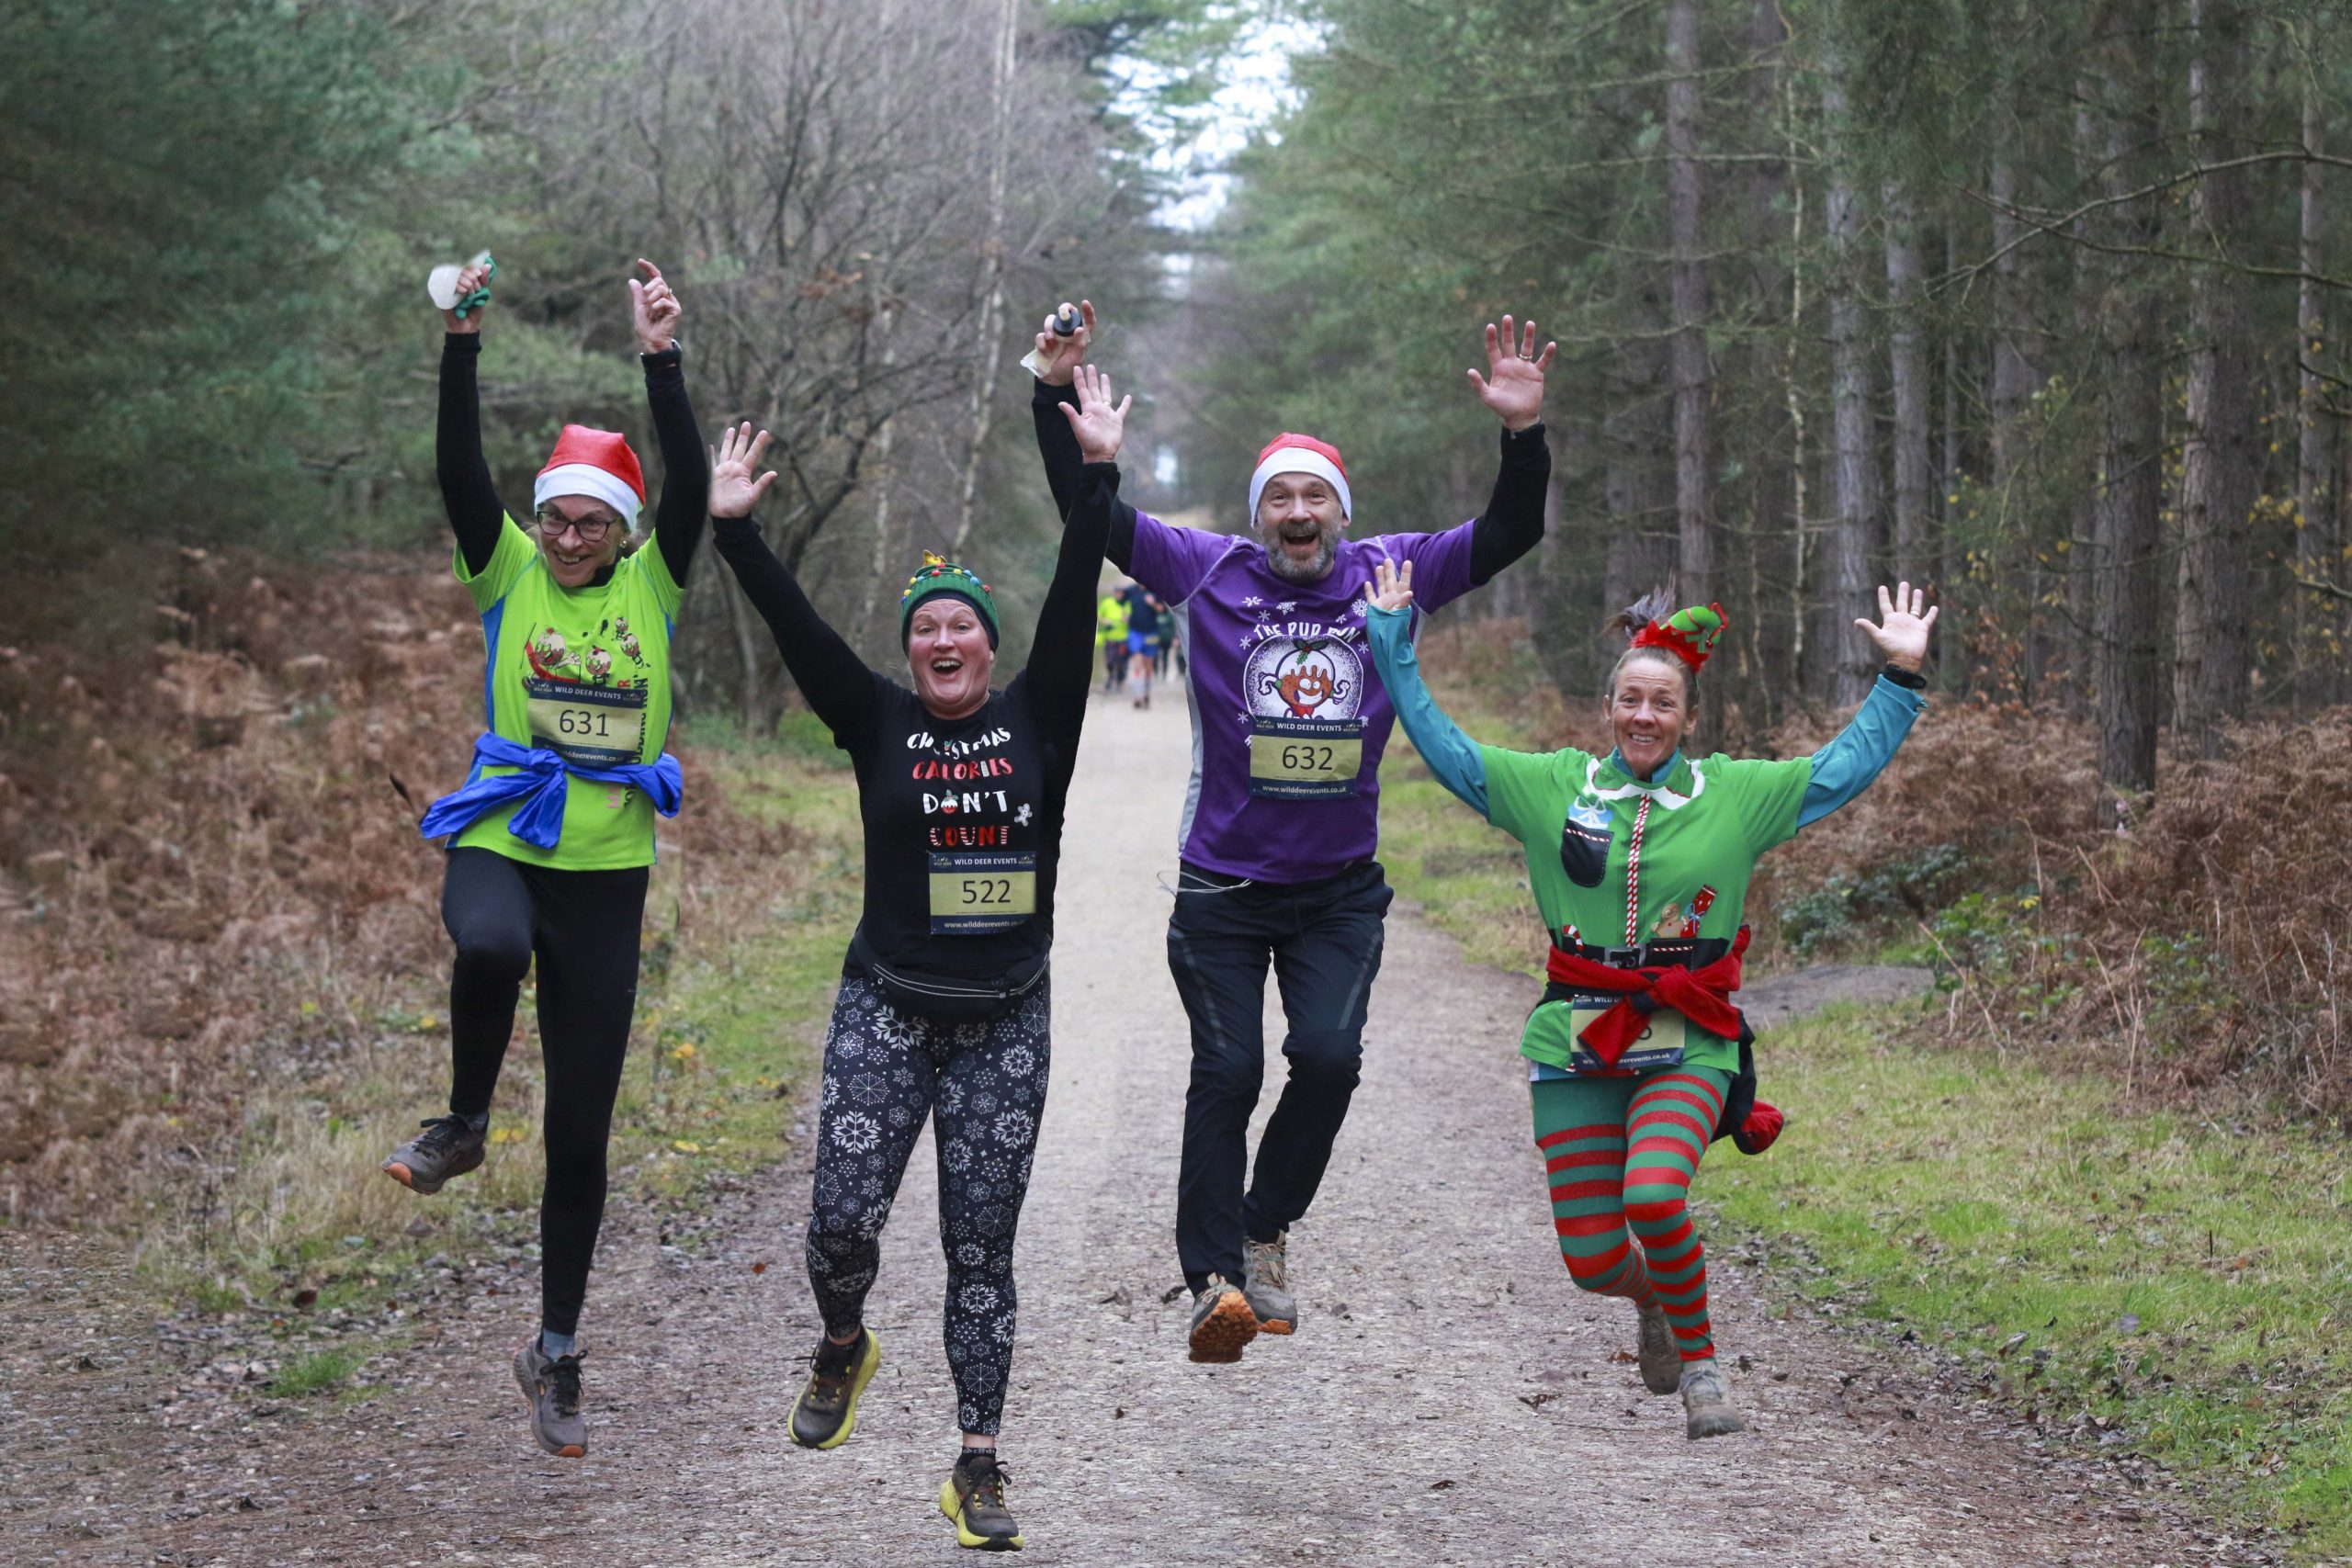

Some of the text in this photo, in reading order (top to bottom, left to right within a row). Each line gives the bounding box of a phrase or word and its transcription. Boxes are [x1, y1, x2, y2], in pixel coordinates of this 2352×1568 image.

[1254, 624, 1283, 640] THE
[1287, 622, 1322, 637] PUD
[574, 688, 594, 696] DEER
[594, 690, 621, 699] EVENTS
[560, 709, 610, 737] 631
[912, 757, 1014, 780] CALORIES
[1282, 745, 1333, 771] 632
[1262, 784, 1347, 795] www.wilddeerevents.co.uk
[930, 825, 1009, 846] COUNT
[962, 879, 1012, 904] 522
